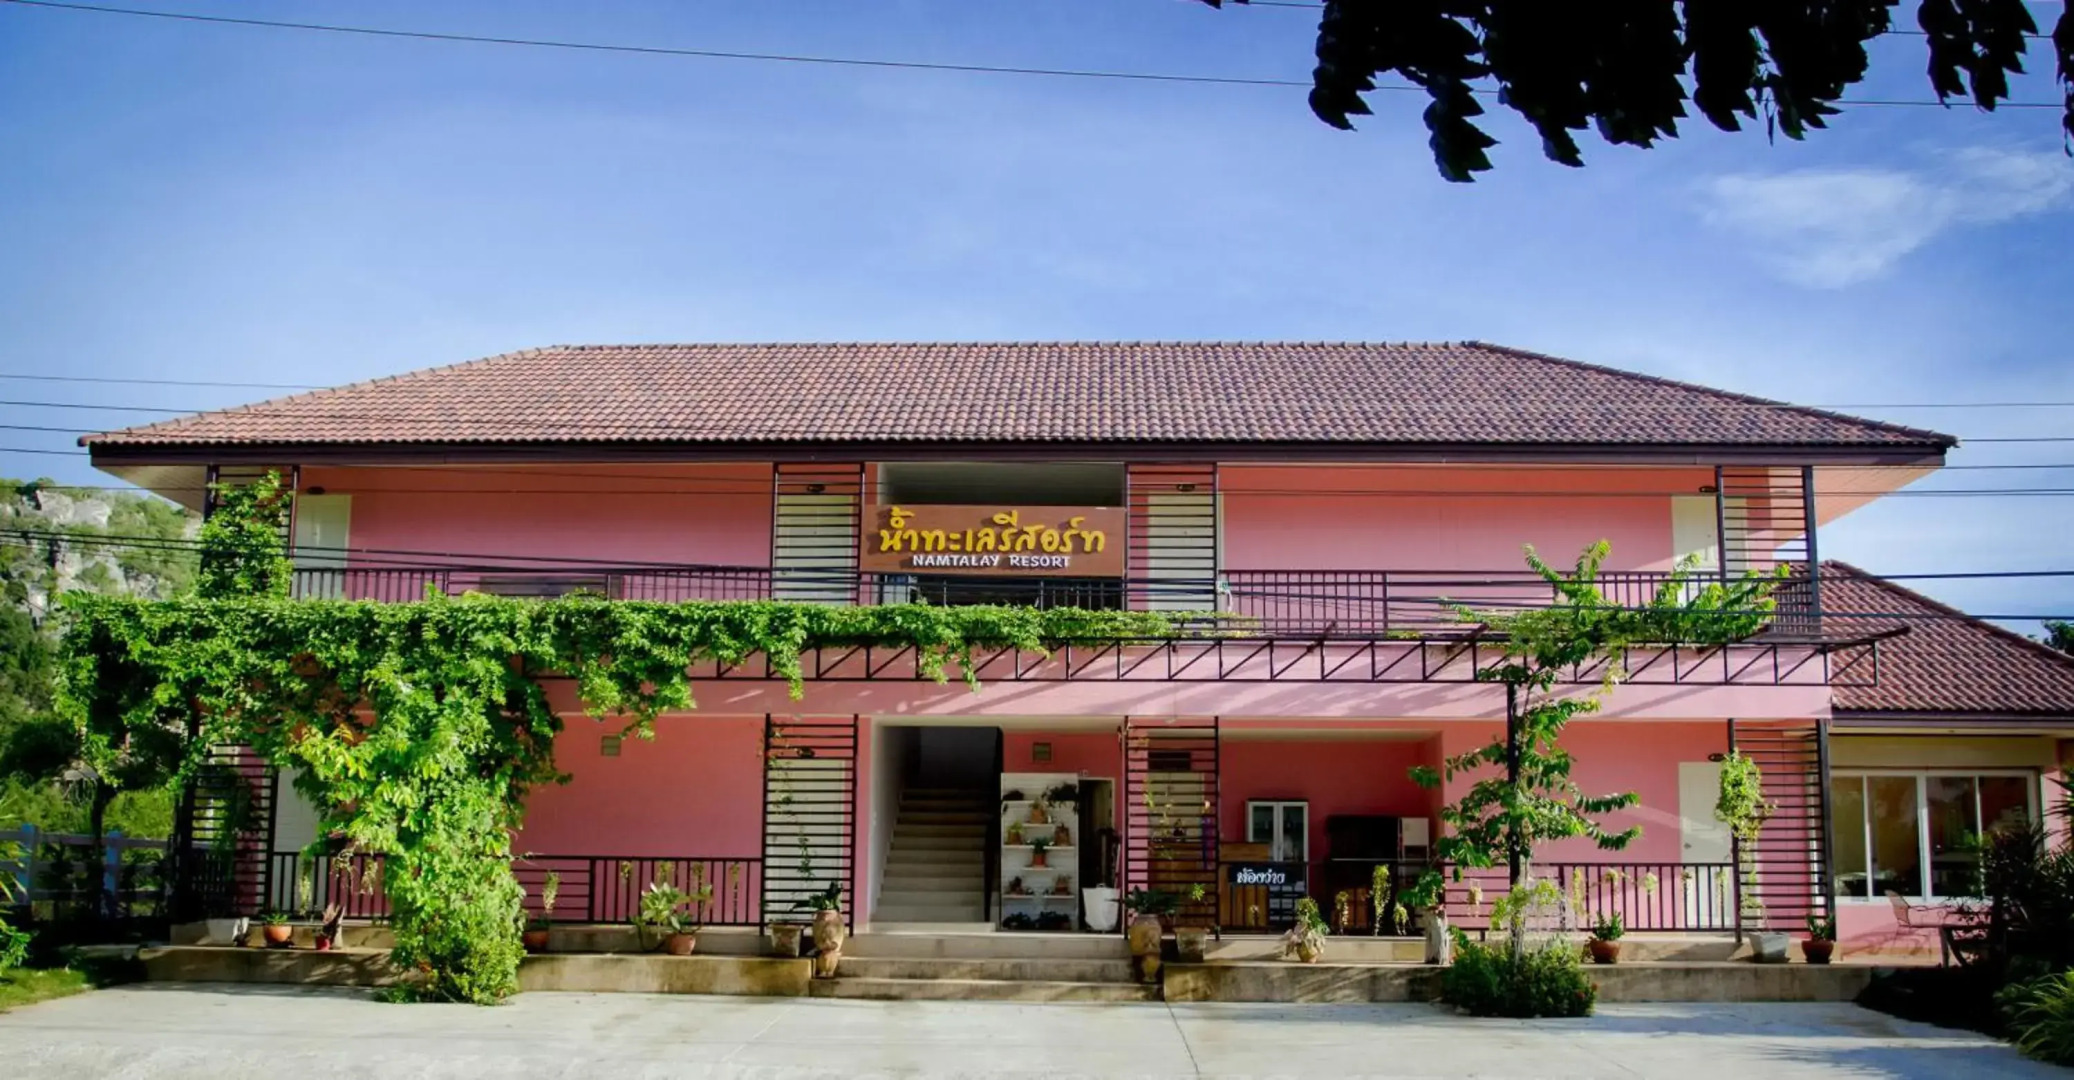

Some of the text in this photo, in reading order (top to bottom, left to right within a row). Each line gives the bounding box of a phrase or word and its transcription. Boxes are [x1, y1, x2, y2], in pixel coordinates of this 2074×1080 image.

[879, 506, 1106, 553] น้ำทะเลรีสอร์ท
[912, 554, 1071, 568] NAMTALAY RESORT
